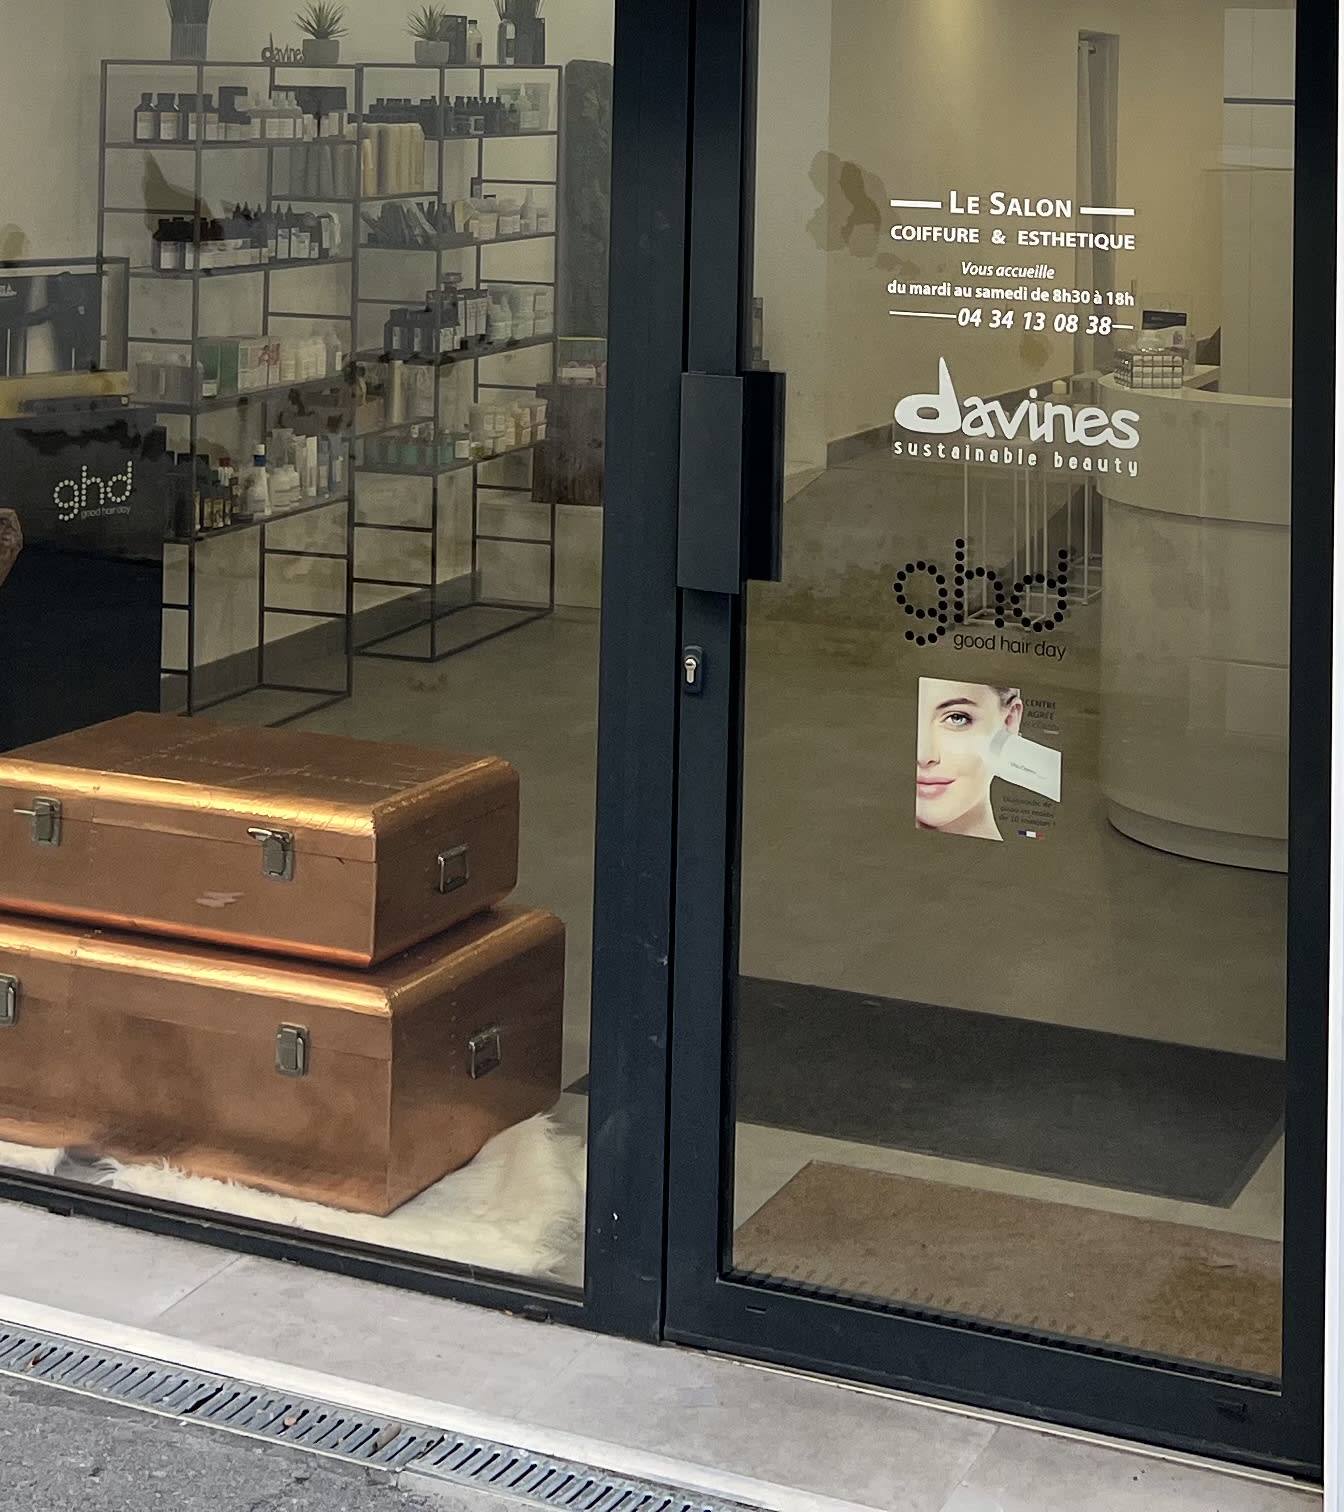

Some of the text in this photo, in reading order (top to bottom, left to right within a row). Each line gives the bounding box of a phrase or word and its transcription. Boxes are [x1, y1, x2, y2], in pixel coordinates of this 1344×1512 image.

[891, 225, 1135, 250] COIFFURE & ESTHETIQUE
[961, 261, 1055, 280] Vous accueille
[887, 280, 1134, 306] du mardi au samedi de 8h30 à 18h
[957, 307, 1111, 335] 04 34 13 08 38
[894, 356, 1140, 449] davines
[894, 439, 1138, 476] sustainable beauty
[54, 460, 133, 521] ghd
[893, 538, 1068, 646] ghd
[954, 633, 1066, 662] good hair day
